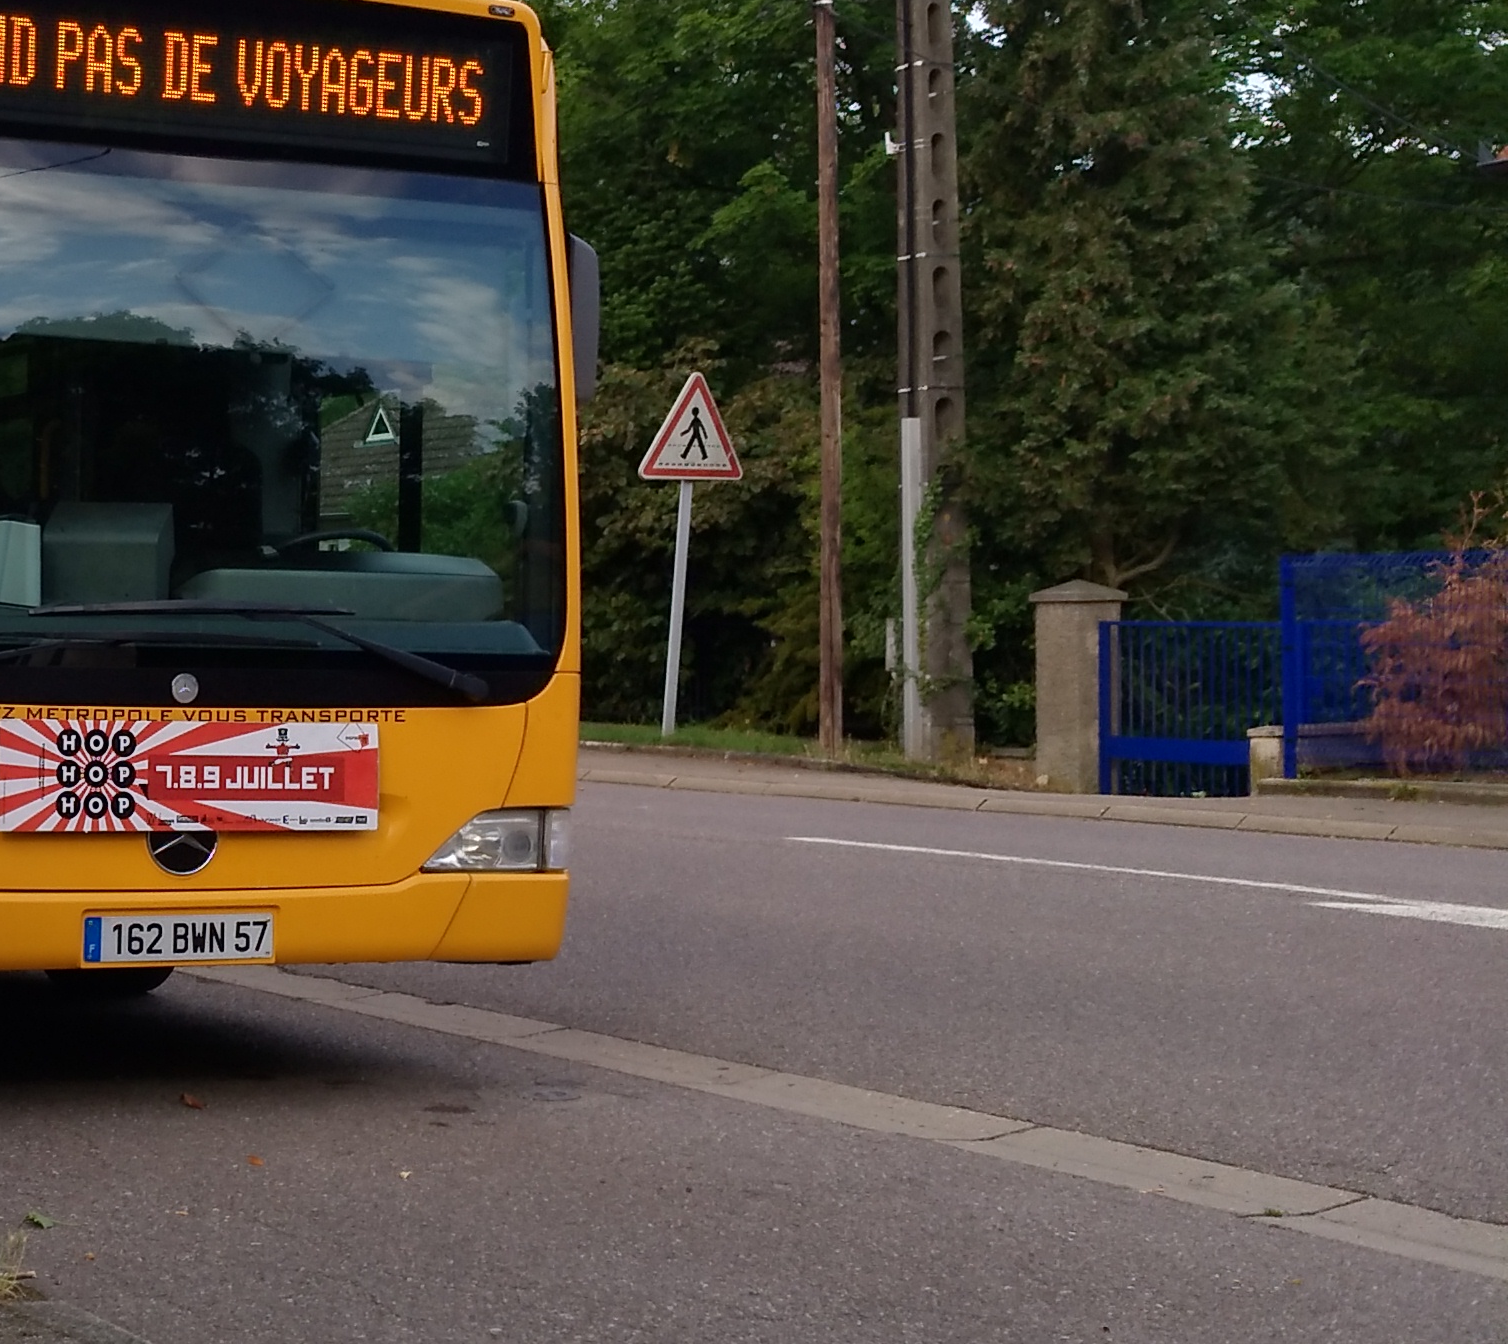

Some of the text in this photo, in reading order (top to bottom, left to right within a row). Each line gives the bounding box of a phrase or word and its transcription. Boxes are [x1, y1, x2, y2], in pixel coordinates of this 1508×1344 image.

[55, 21, 143, 96] PAS
[161, 31, 218, 103] DE
[236, 39, 484, 125] VOYAGEURS
[26, 706, 174, 722] METROPOLE
[181, 709, 248, 723] VOUS
[257, 709, 406, 724] TRANSPORTE
[60, 734, 131, 752] HOP
[59, 765, 131, 783] HOP
[155, 765, 335, 790] 7.8.9 JUILLET
[59, 796, 130, 814] HOP
[112, 922, 163, 955] 162
[172, 921, 225, 954] BWN
[234, 920, 270, 953] 57
